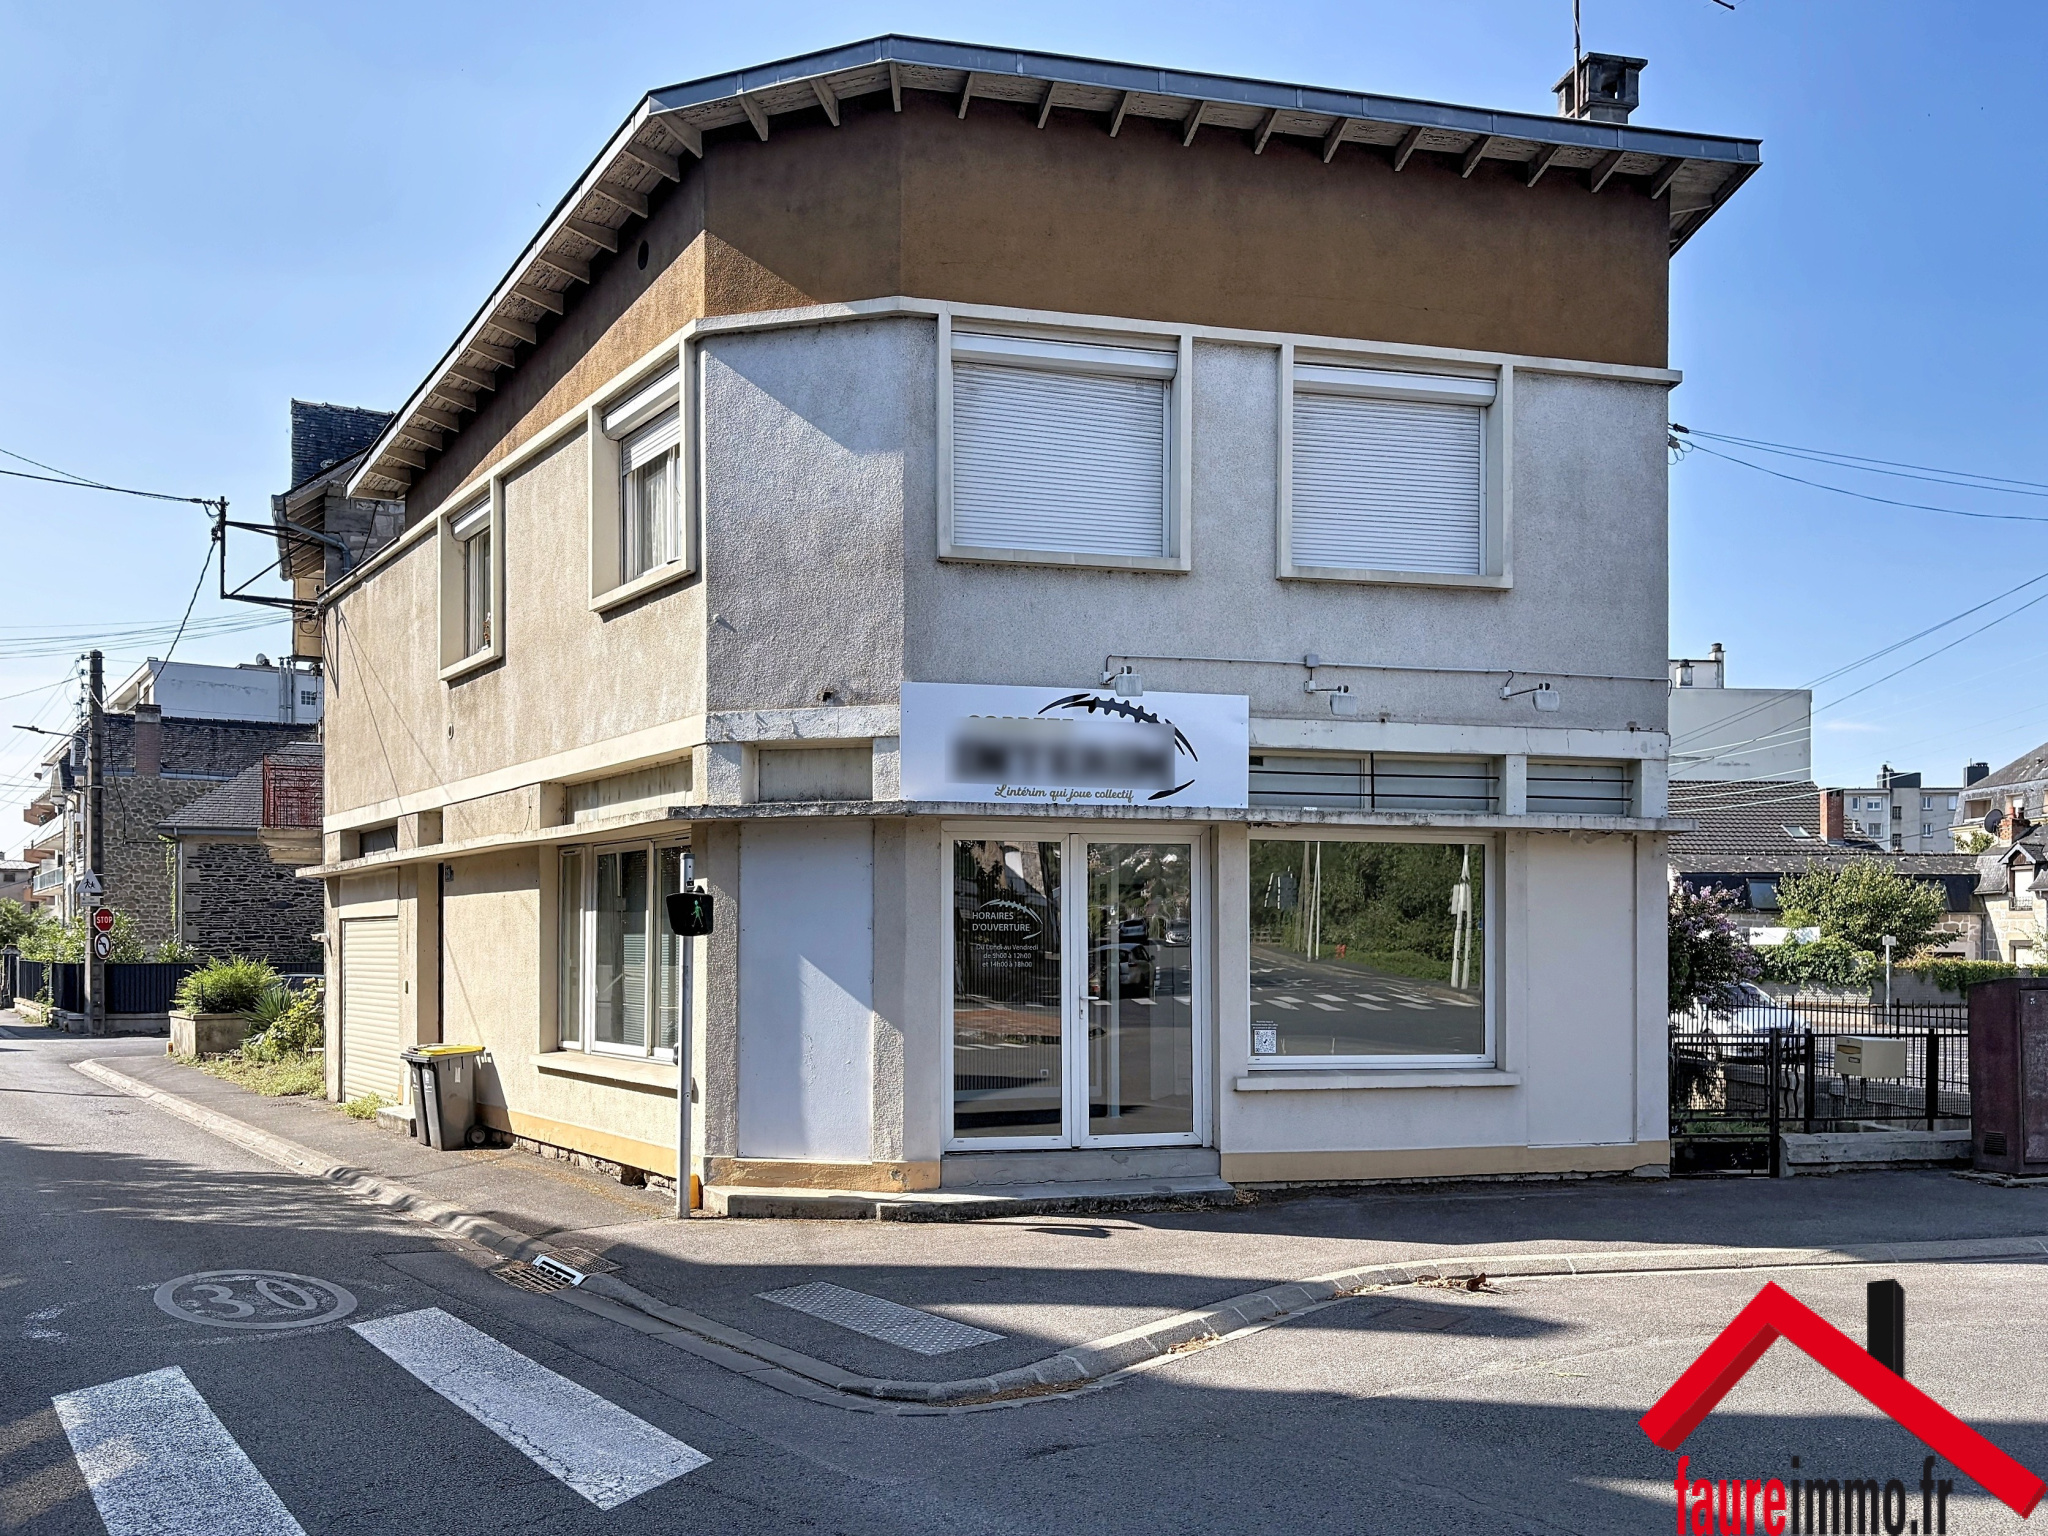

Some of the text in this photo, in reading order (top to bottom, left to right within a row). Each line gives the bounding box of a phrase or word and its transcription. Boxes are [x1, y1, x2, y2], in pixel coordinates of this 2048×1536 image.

[1049, 788, 1067, 801] qui
[1066, 789, 1092, 802] joue
[1095, 789, 1134, 803] collectif
[96, 915, 113, 924] STOP
[972, 911, 1014, 920] HORAIRES
[972, 923, 1031, 932] D'OUVERTURE
[1012, 943, 1039, 951] Vendredi
[192, 1278, 319, 1319] 30
